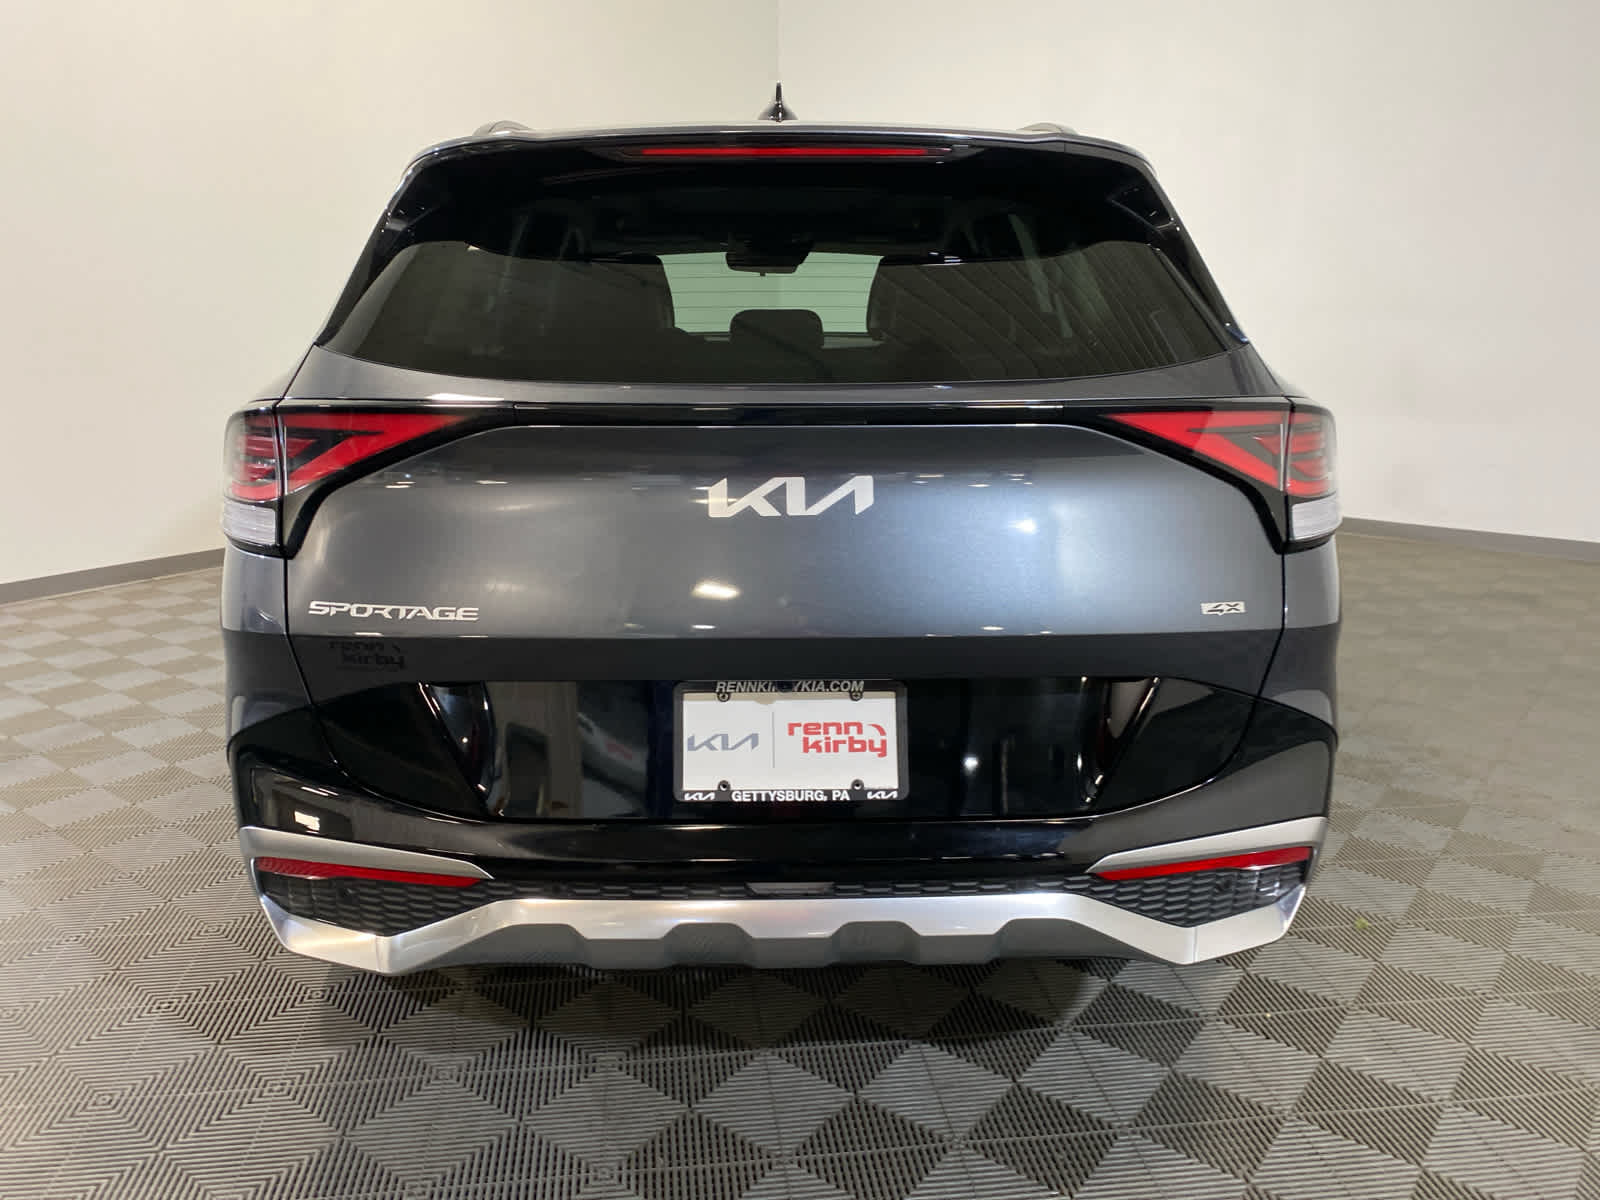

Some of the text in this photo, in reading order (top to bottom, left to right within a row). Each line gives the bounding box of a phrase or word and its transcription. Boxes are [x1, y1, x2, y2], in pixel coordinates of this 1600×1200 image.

[708, 475, 875, 517] KIA
[308, 600, 480, 621] SPORTAGE
[715, 680, 864, 693] RENNKIYKIA.COM
[788, 722, 863, 736] renn
[687, 733, 759, 752] KIA
[802, 736, 887, 758] kirby
[684, 791, 716, 801] KIA
[731, 790, 850, 802] GETTYSBURG, PA
[866, 791, 899, 800] KIA
